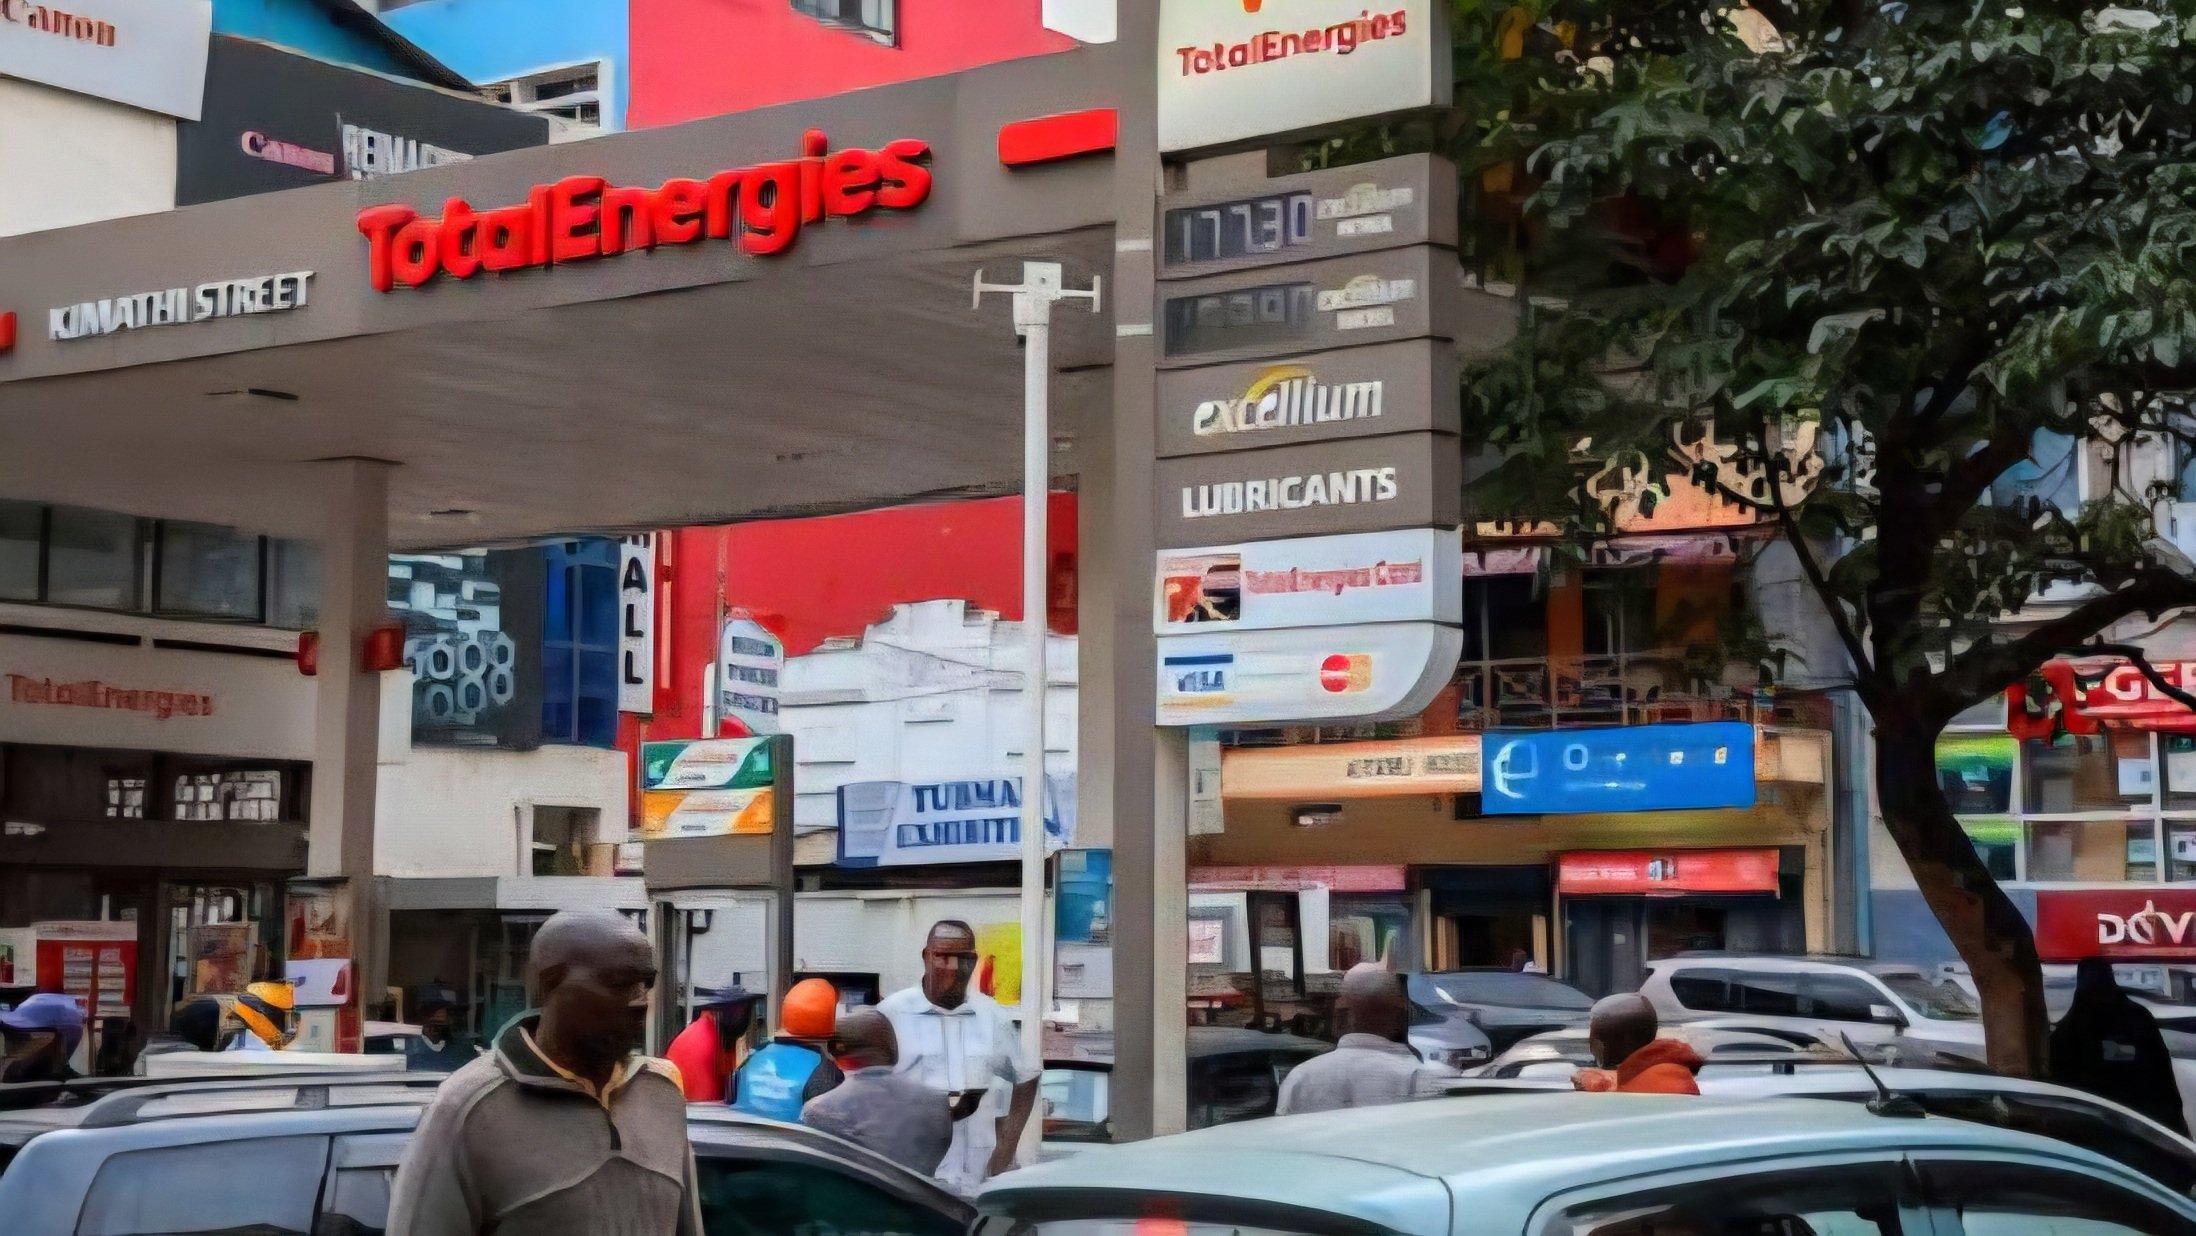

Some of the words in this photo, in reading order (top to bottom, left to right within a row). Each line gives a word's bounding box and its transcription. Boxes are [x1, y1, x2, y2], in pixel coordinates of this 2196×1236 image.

[1177, 10, 1406, 76] TotalEnergies
[356, 128, 932, 292] TotalEnergies
[195, 271, 316, 320] STREET
[1182, 467, 1397, 518] LUBRICANTS
